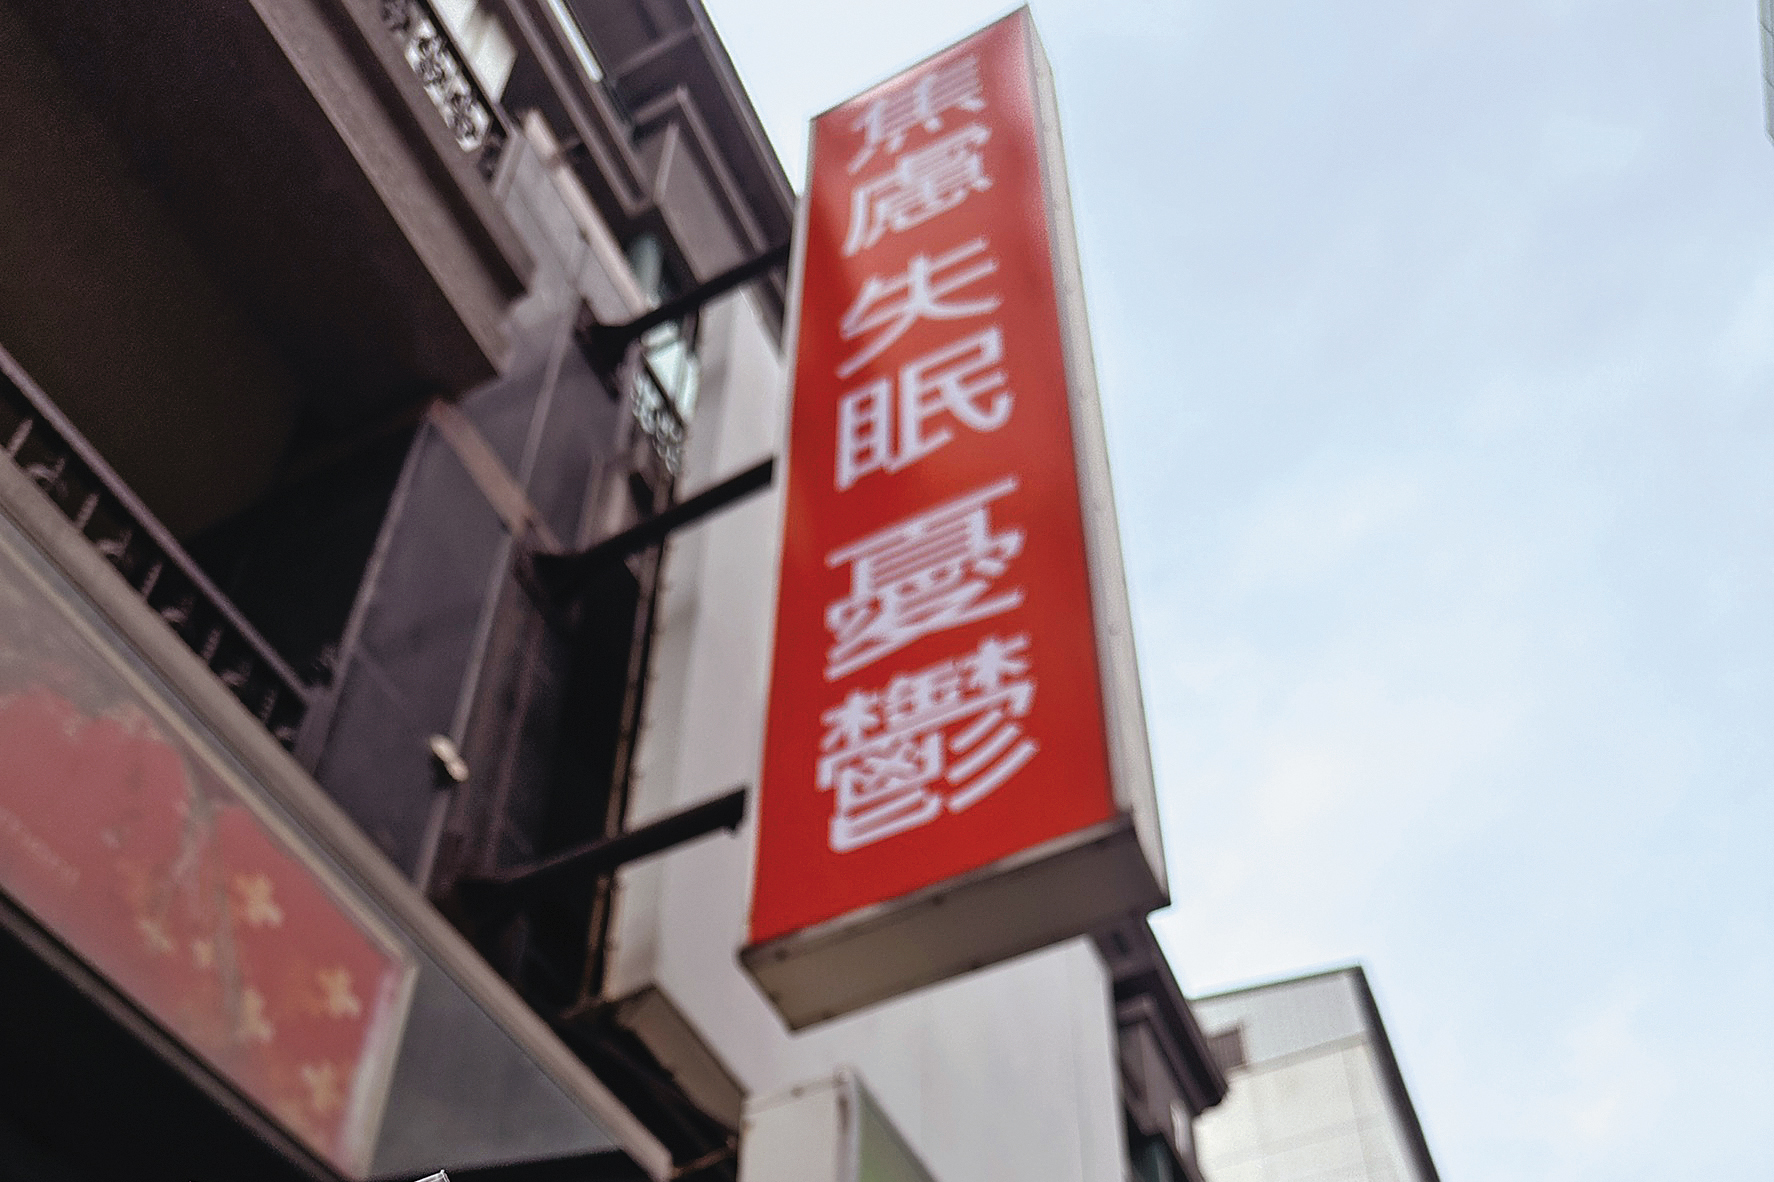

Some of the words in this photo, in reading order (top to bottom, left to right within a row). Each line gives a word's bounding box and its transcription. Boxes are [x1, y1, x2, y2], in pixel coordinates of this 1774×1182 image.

[845, 54, 991, 258] 焦慮
[837, 236, 1014, 491] 失眠
[815, 475, 1040, 853] 憂鬱
